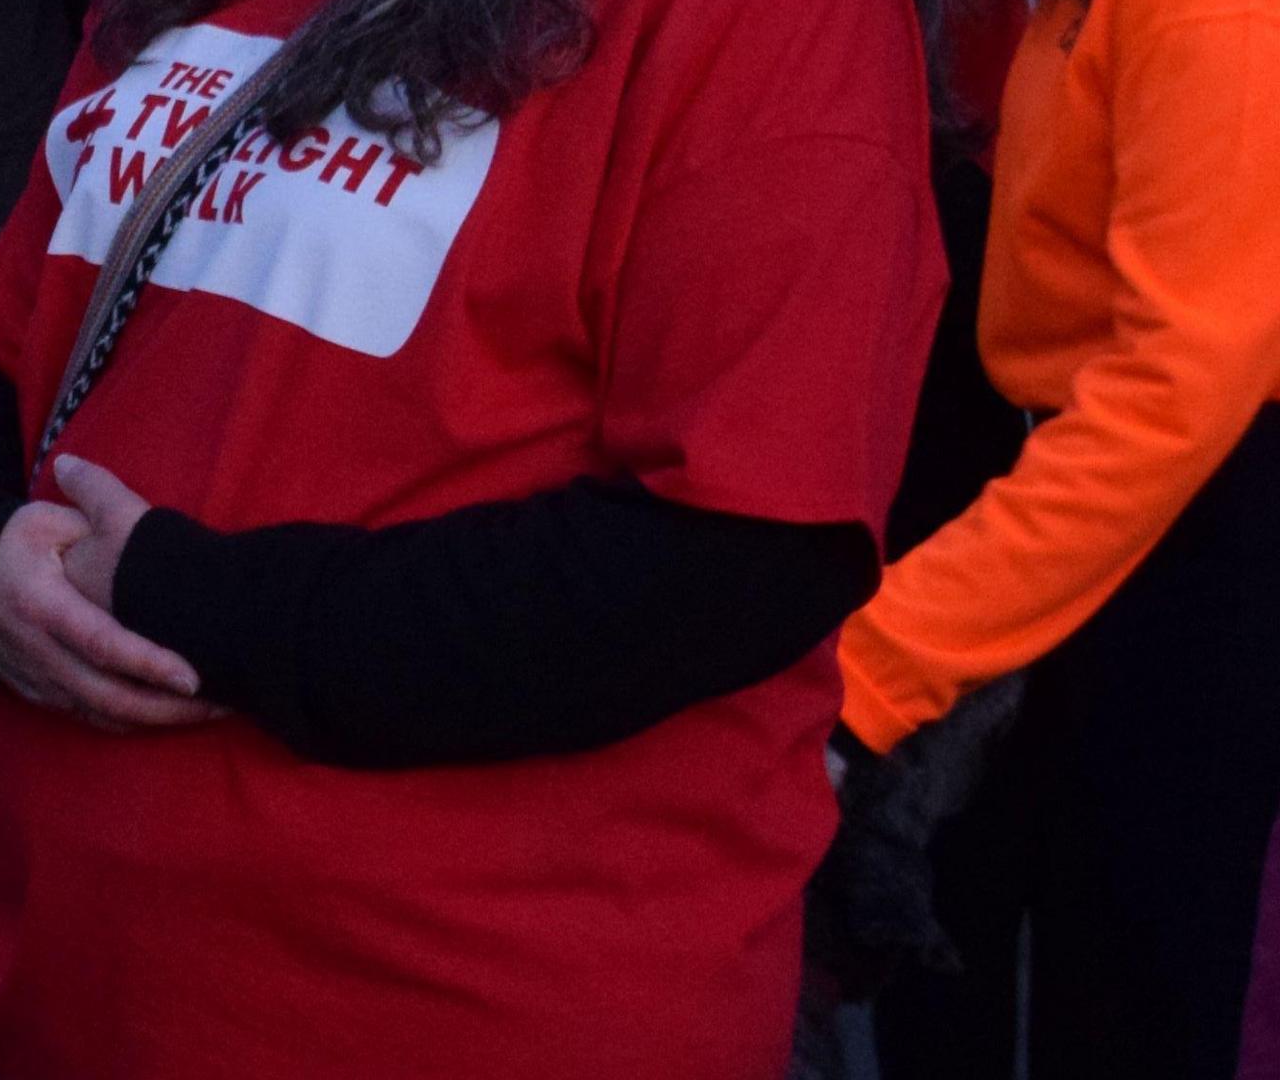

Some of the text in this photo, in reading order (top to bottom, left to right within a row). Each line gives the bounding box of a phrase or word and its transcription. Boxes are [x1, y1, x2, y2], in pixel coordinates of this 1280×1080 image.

[158, 61, 234, 100] THE
[108, 146, 268, 225] WLK
[126, 94, 426, 208] TWLIGHT
